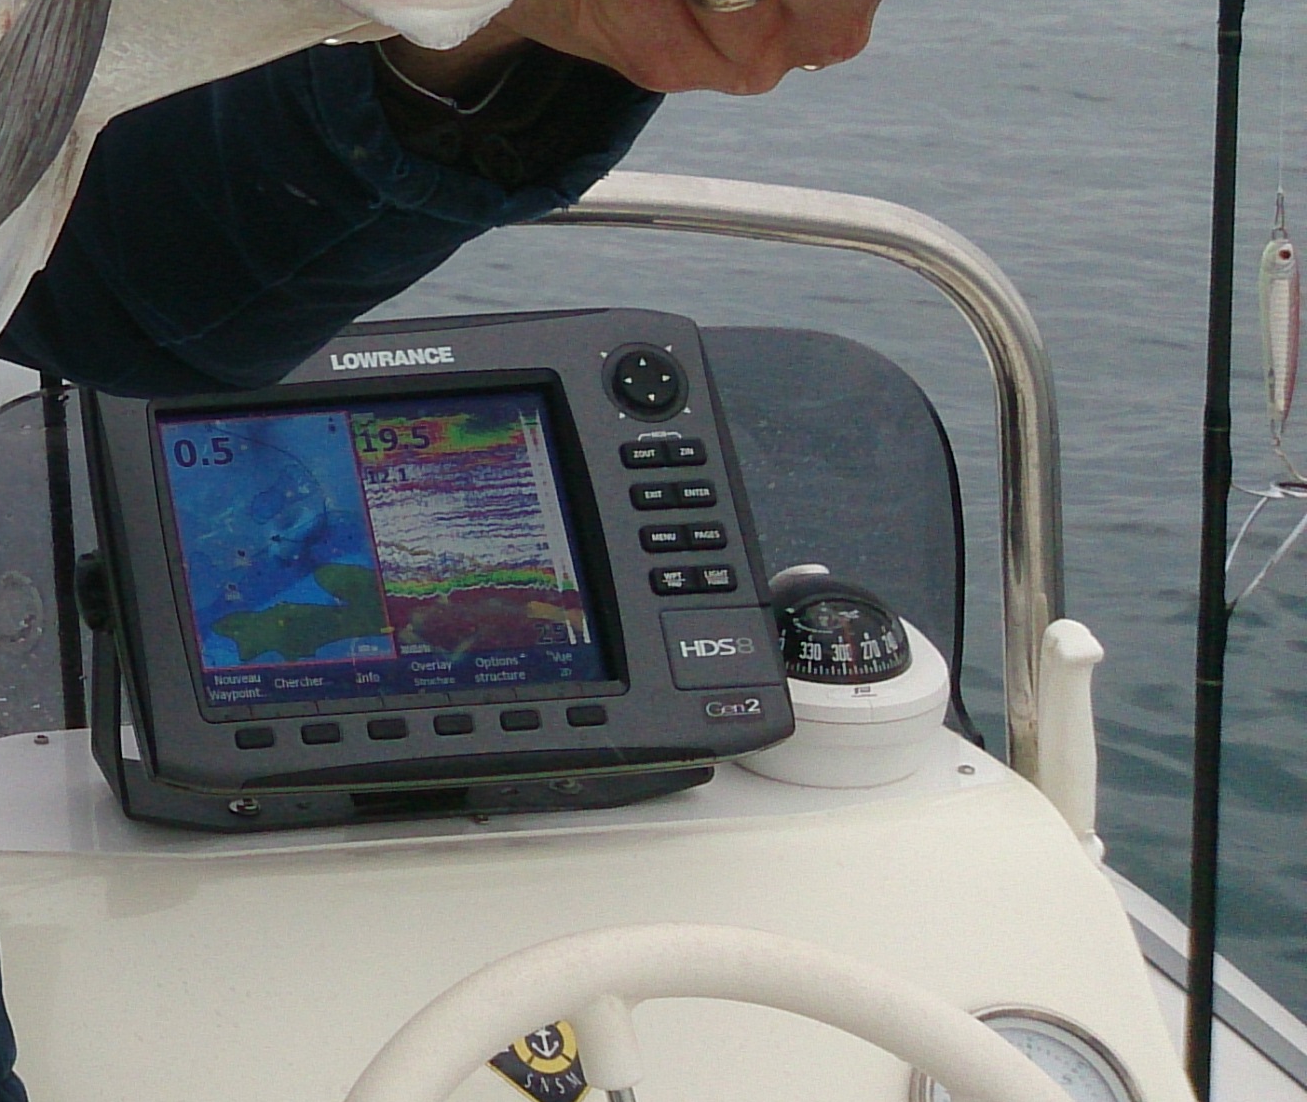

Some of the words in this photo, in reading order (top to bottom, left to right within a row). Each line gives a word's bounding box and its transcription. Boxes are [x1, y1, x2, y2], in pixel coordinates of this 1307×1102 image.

[330, 346, 455, 371] LOWRANCE
[360, 425, 431, 453] 19.5
[173, 436, 235, 468] 0.5
[633, 449, 656, 459] ZOUT
[644, 490, 662, 499] EXIT
[684, 488, 710, 498] ENTER
[651, 533, 676, 542] MENU
[694, 530, 721, 540] PAGES
[798, 641, 823, 661] 330
[860, 639, 882, 660] 270
[410, 660, 452, 673] Overlay
[475, 655, 519, 669] Options
[214, 673, 261, 686] Nouveau
[274, 676, 324, 689] Chercher
[354, 672, 380, 684] Info
[474, 669, 526, 684] structure
[705, 698, 762, 717] Gen2
[524, 1071, 584, 1095] SNSM
